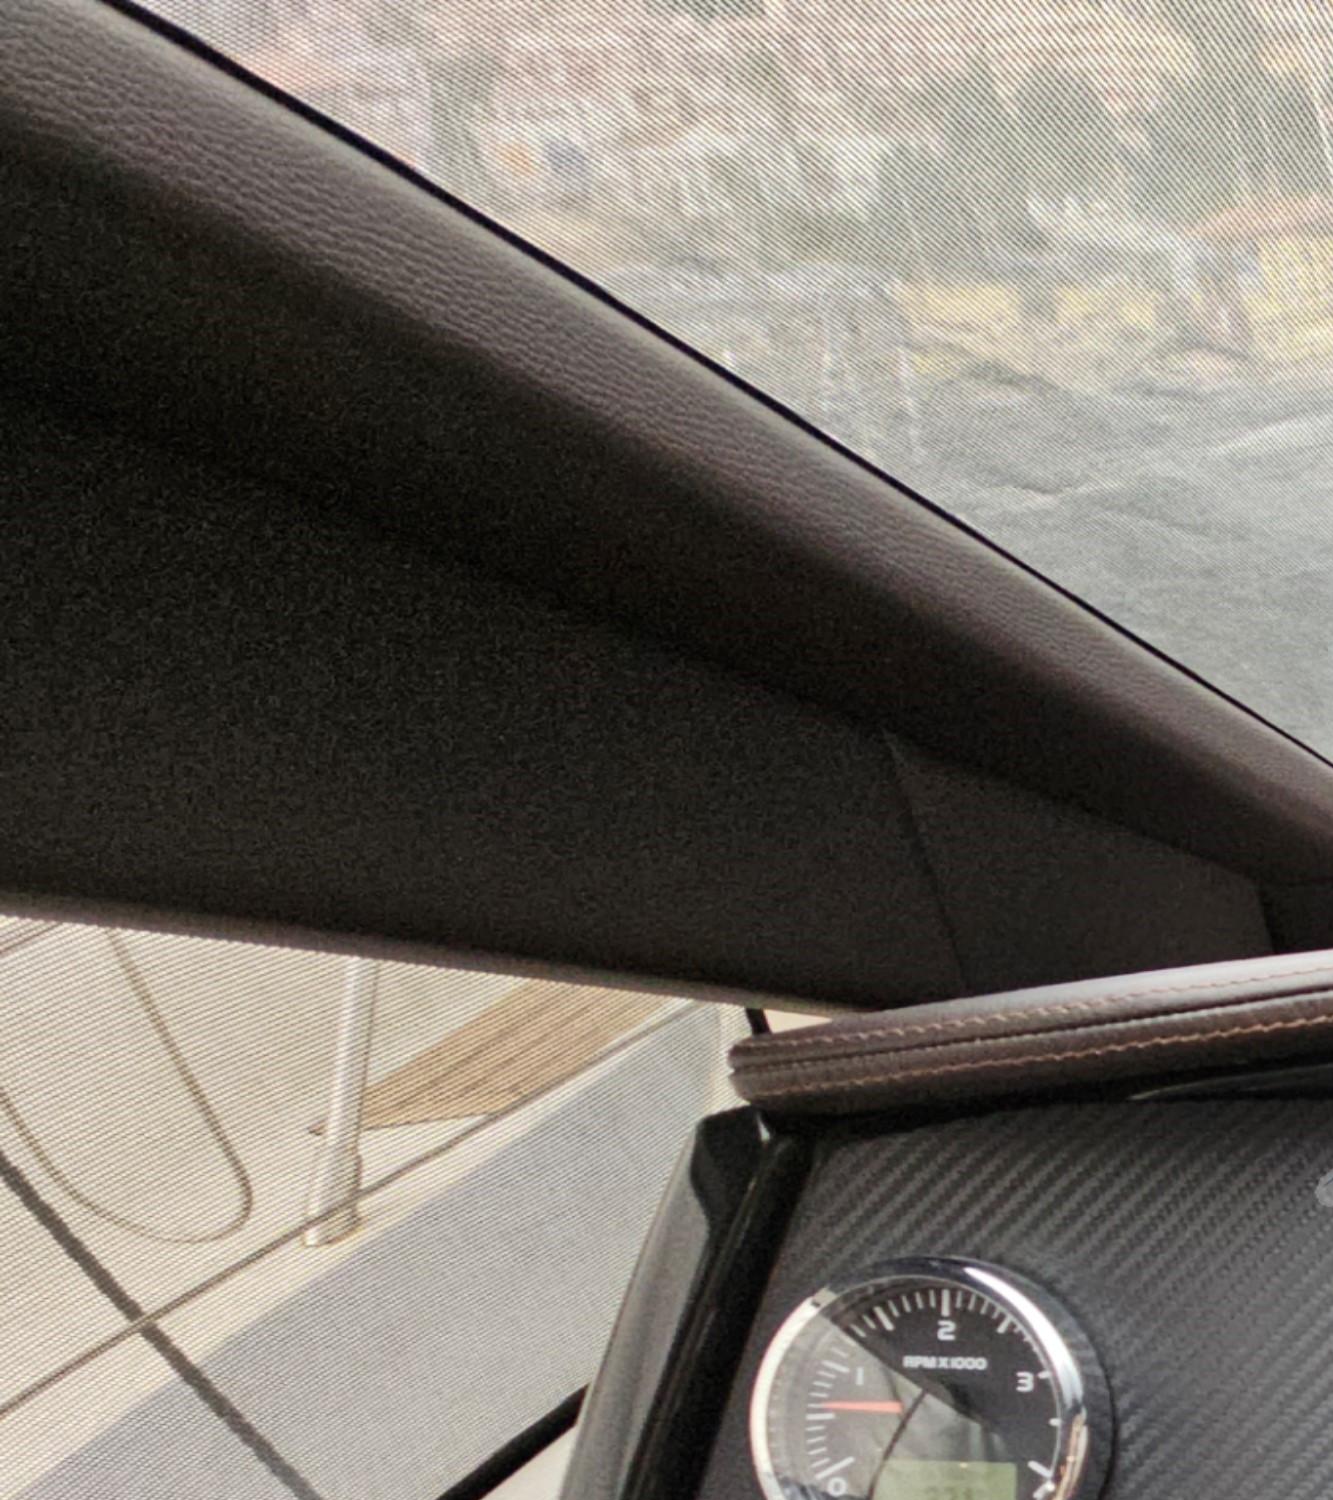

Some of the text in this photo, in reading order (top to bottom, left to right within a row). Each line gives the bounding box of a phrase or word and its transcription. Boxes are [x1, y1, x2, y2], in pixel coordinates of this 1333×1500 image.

[937, 1319, 957, 1341] 2
[1016, 1372, 1035, 1393] 3
[827, 1477, 848, 1498] 0
